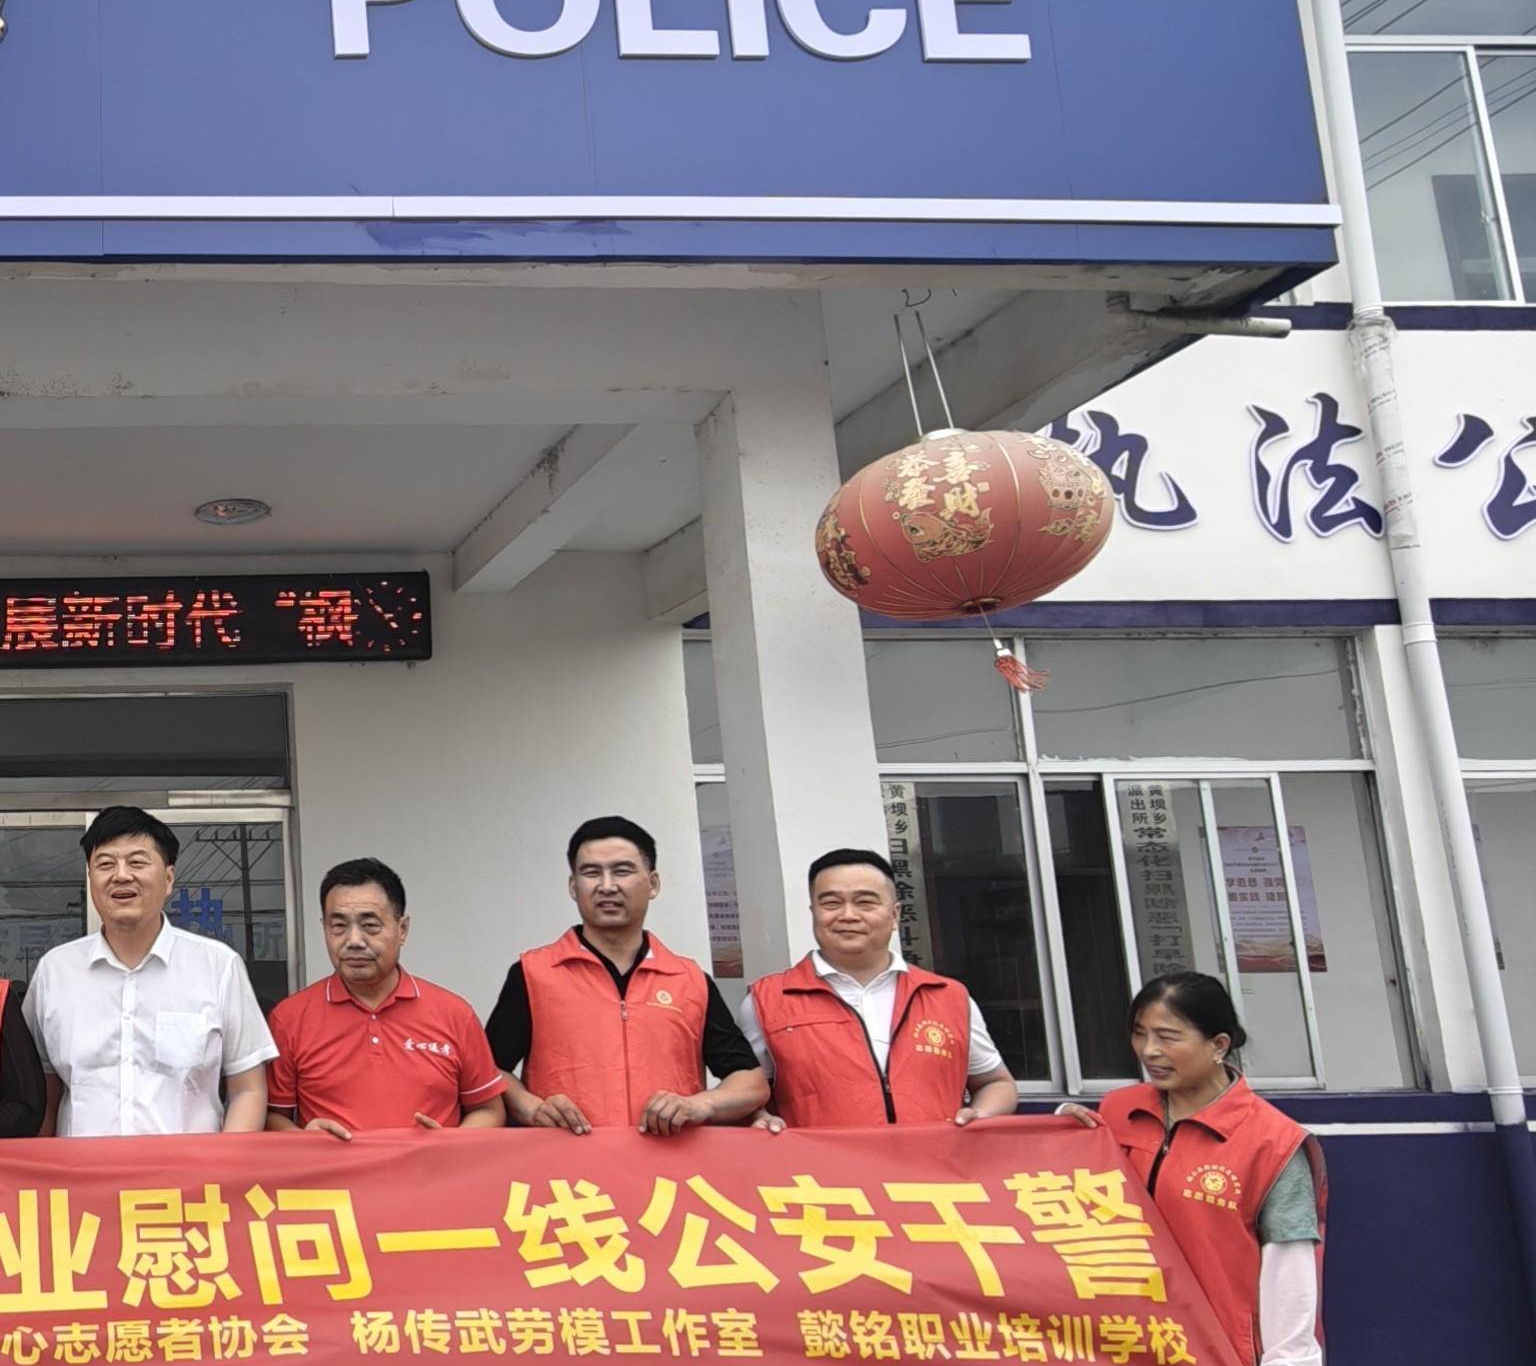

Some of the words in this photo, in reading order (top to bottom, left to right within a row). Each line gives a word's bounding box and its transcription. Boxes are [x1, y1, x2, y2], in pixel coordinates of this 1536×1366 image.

[350, 1306, 765, 1360] 杨传武劳模工作室
